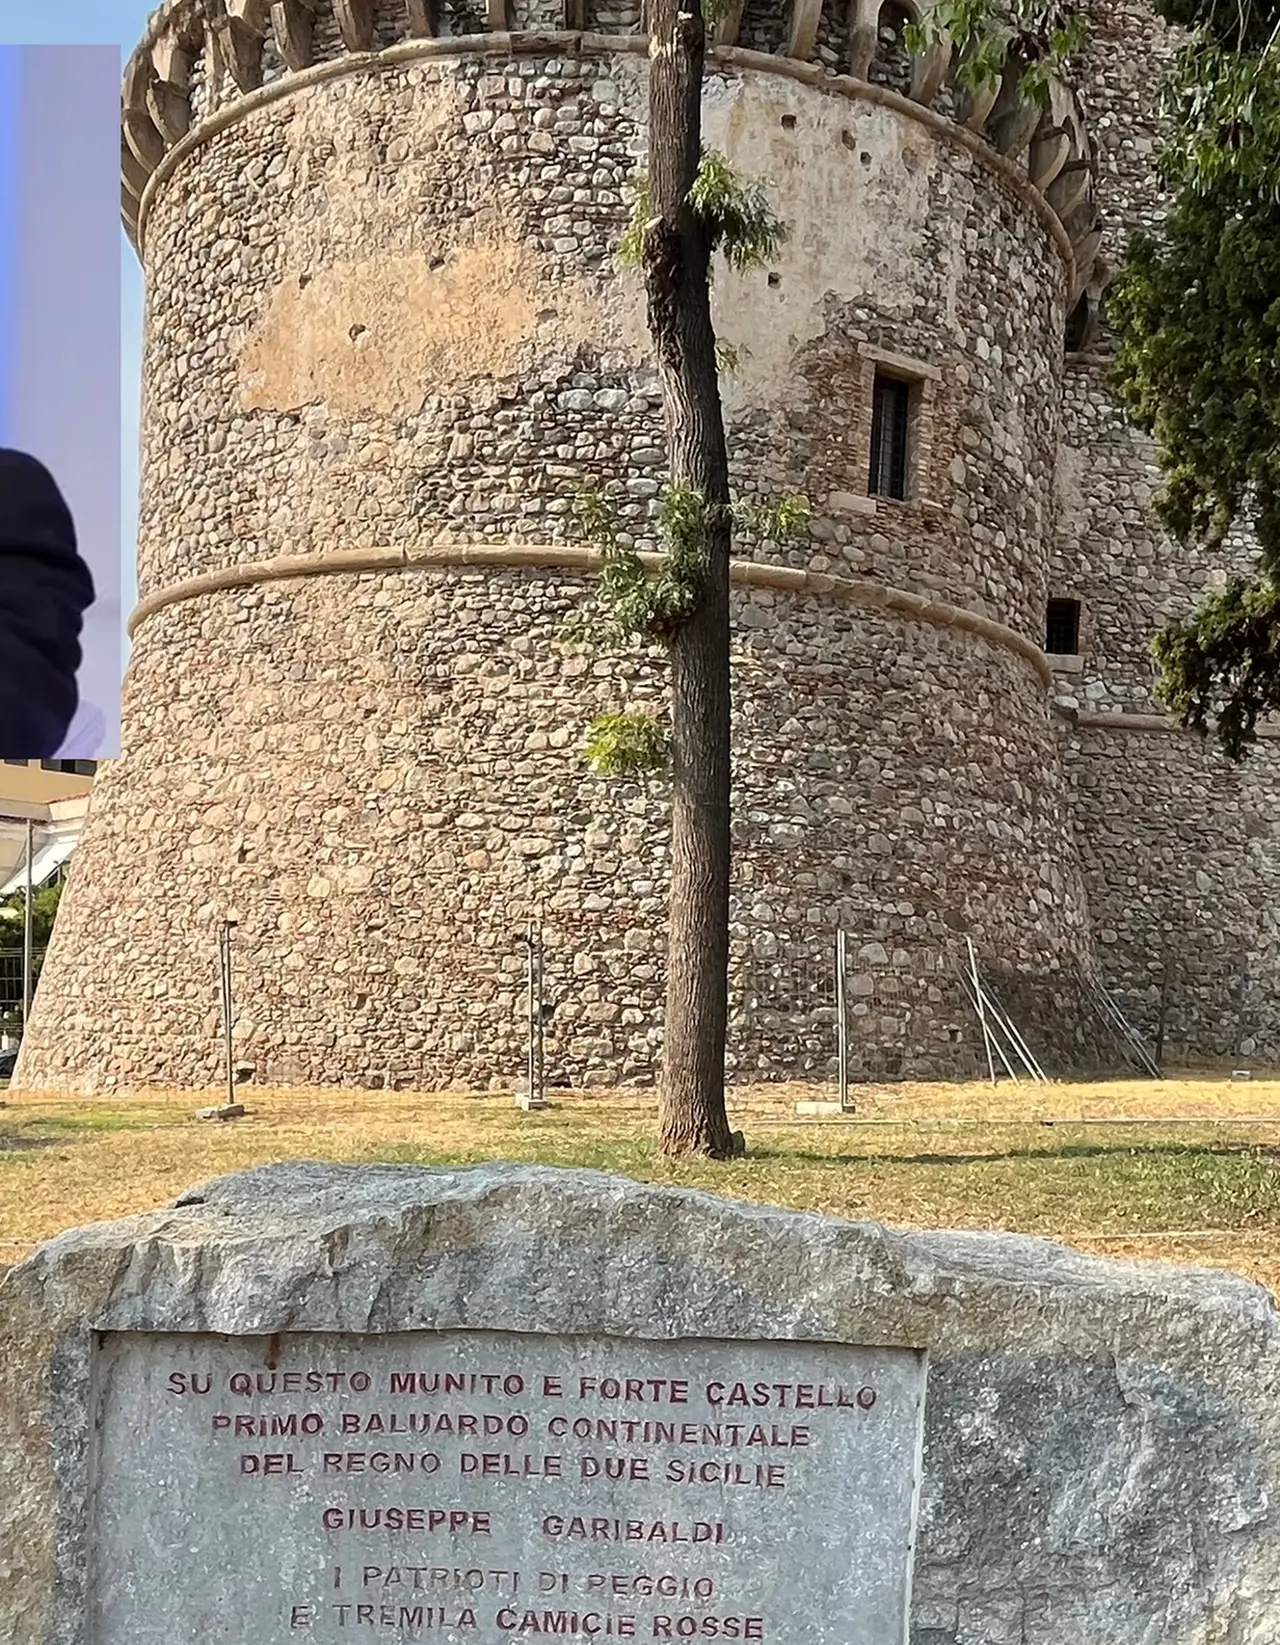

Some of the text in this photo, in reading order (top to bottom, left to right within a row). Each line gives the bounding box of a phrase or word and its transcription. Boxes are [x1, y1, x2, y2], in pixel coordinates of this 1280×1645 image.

[168, 1371, 877, 1409] SU QUESTO MUNITO E FORTE CASTELLO
[212, 1413, 811, 1448] PRIMO BALUARDO CONTINENTALE
[239, 1452, 786, 1488] DEL REGNO DELLE DUE SICILIE
[322, 1508, 724, 1543] GIUSEPPE GARIBALDI
[333, 1566, 342, 1589] I
[362, 1566, 520, 1592] PATRIOTI
[538, 1571, 570, 1594] DI
[290, 1604, 765, 1640] E TREMILA CAMICIE ROSSE
